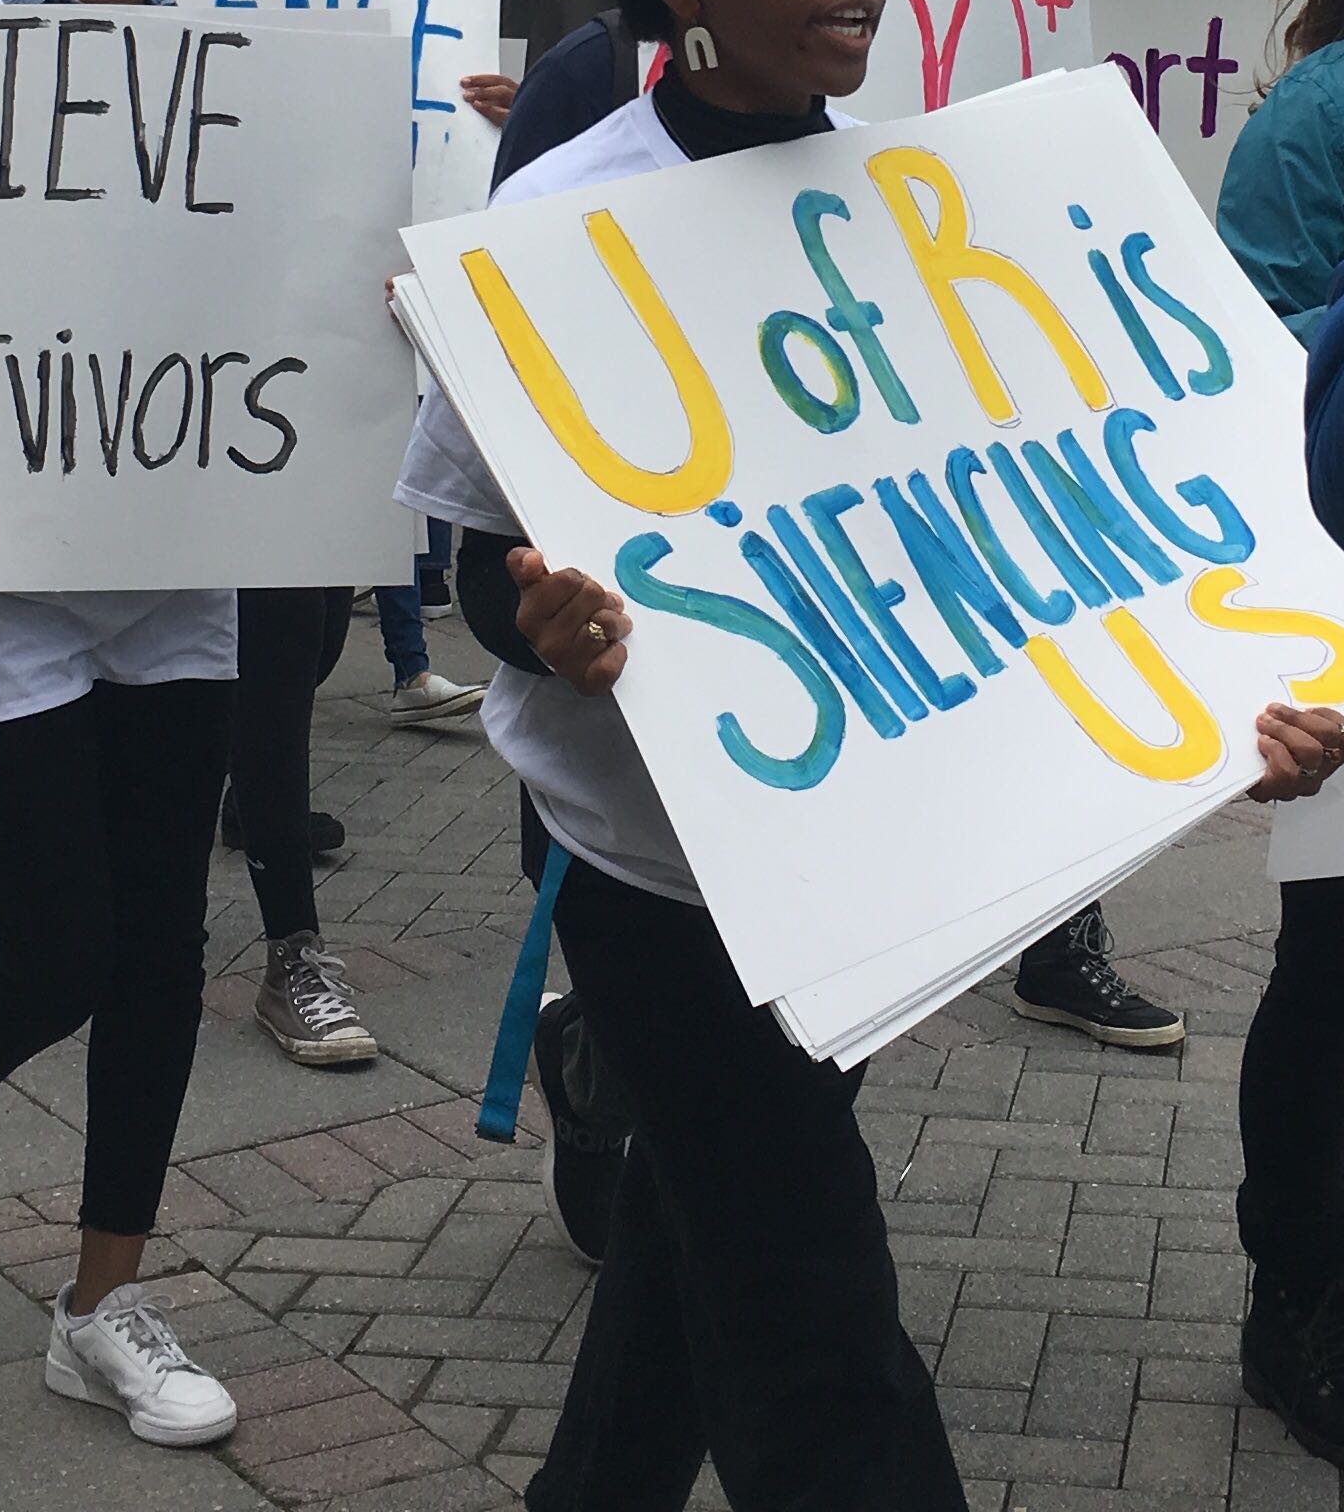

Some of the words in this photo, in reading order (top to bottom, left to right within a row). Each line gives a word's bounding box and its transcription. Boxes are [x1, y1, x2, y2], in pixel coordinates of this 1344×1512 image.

[459, 208, 736, 518] U
[757, 188, 922, 435] of
[863, 145, 1114, 428] R
[1068, 202, 1235, 403] is
